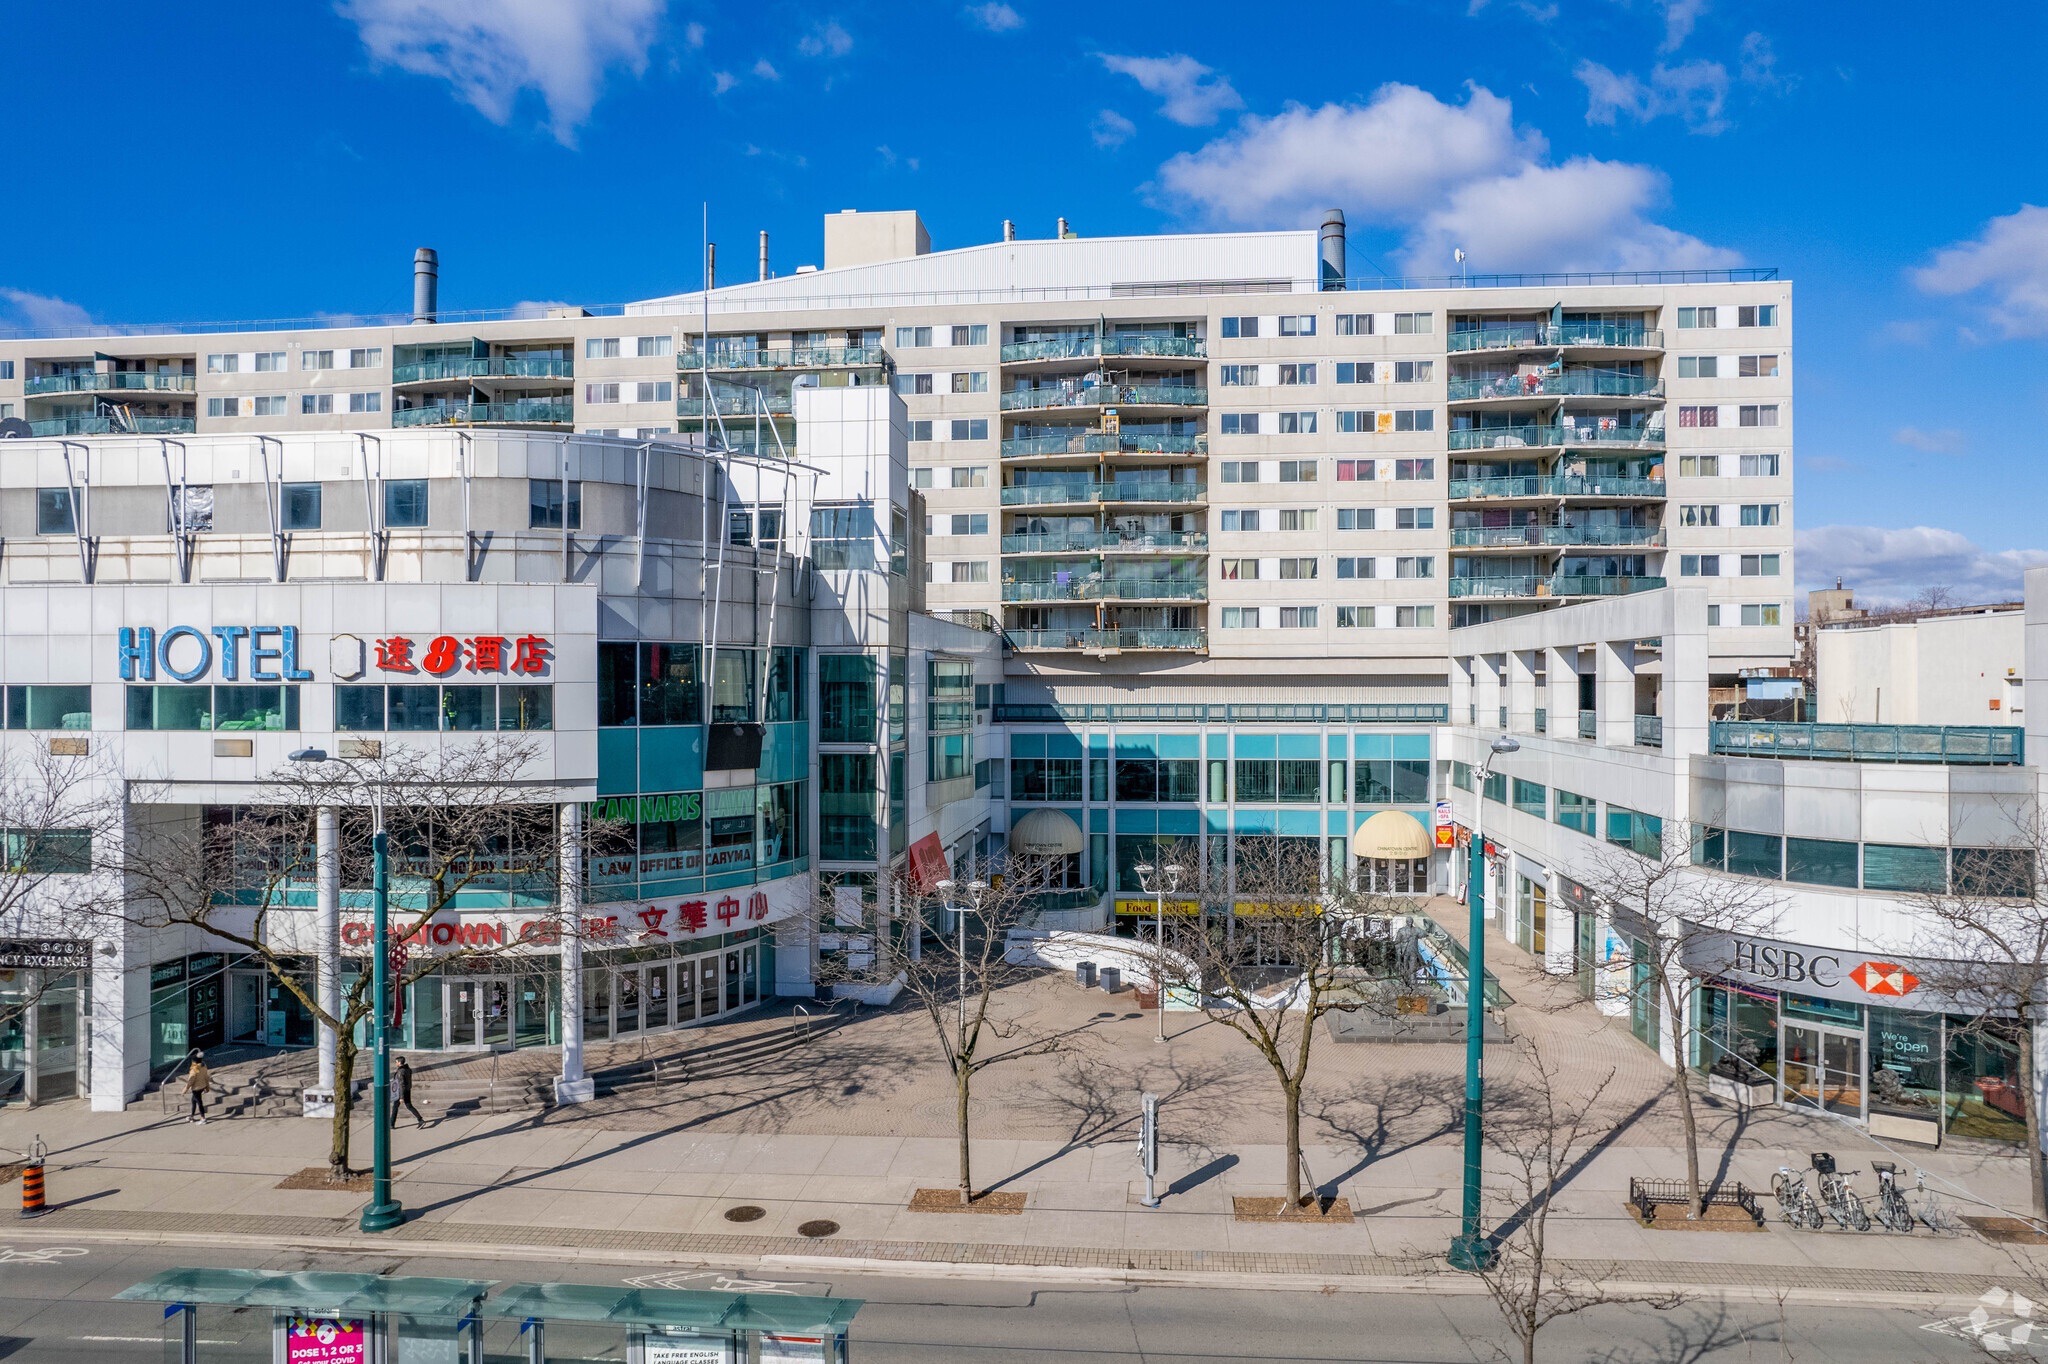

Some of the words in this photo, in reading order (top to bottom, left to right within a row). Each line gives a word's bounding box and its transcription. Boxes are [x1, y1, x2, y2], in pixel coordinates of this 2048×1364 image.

[118, 625, 312, 681] HOTEL
[375, 634, 548, 675] 速8酒店
[592, 793, 701, 824] CANNABIS
[598, 861, 632, 876] LAW
[640, 856, 683, 873] OFFICE
[686, 854, 703, 868] OF
[705, 849, 751, 866] CARYMA
[638, 891, 769, 941] 文華中心
[1126, 902, 1152, 913] Food
[341, 921, 502, 946] CHNATOWN
[520, 916, 618, 945] CERE
[24, 955, 87, 967] EXCHANGE
[1732, 939, 1840, 988] HSBC
[1881, 1031, 1909, 1042] We're
[1895, 1041, 1929, 1053] open
[292, 1348, 320, 1359] DOSE
[321, 1347, 329, 1358] 1,
[330, 1346, 337, 1356] 2
[339, 1345, 355, 1355] OR
[356, 1344, 363, 1353] 3
[330, 1356, 356, 1364] COVID
